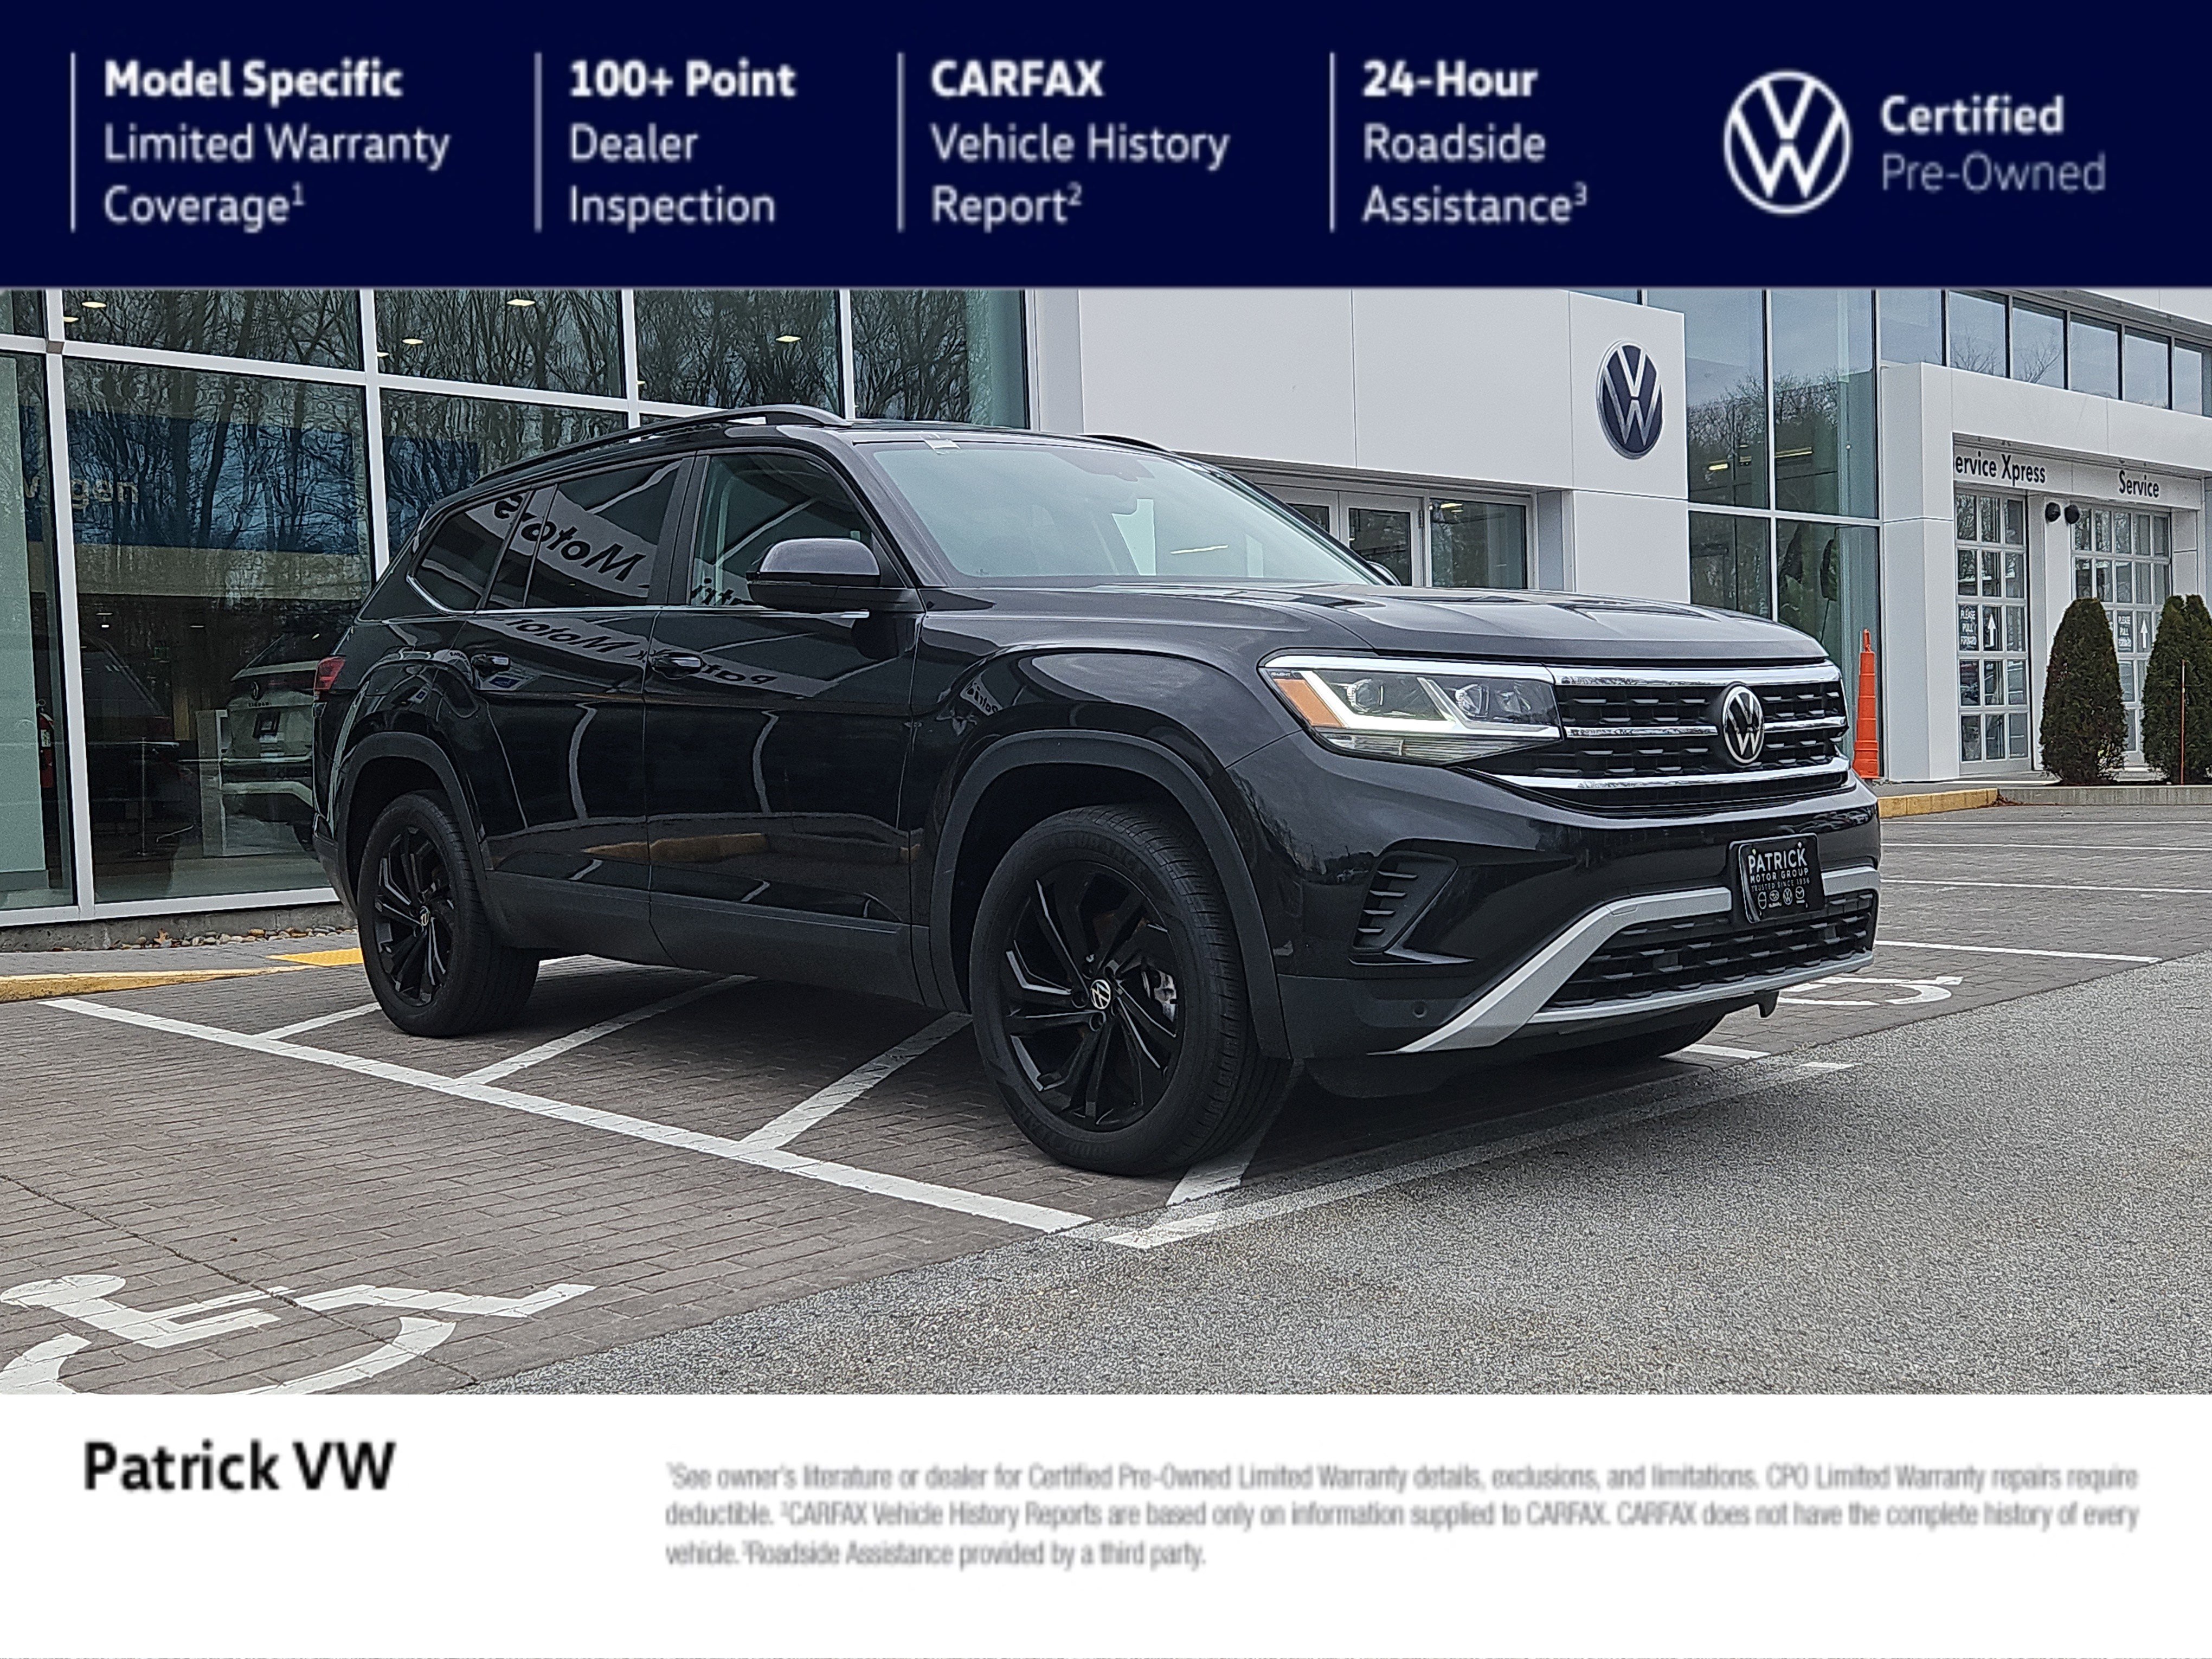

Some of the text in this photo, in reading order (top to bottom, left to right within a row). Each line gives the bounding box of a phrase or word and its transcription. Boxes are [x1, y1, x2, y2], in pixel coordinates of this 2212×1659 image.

[1953, 451, 2046, 486] ervice Xpress
[2119, 470, 2159, 498] Service
[1747, 848, 1808, 874] PATRICK
[1750, 867, 1809, 884] MOTOR GROUP
[1751, 882, 1776, 892] TRUSTED
[1777, 879, 1794, 889] SINCE
